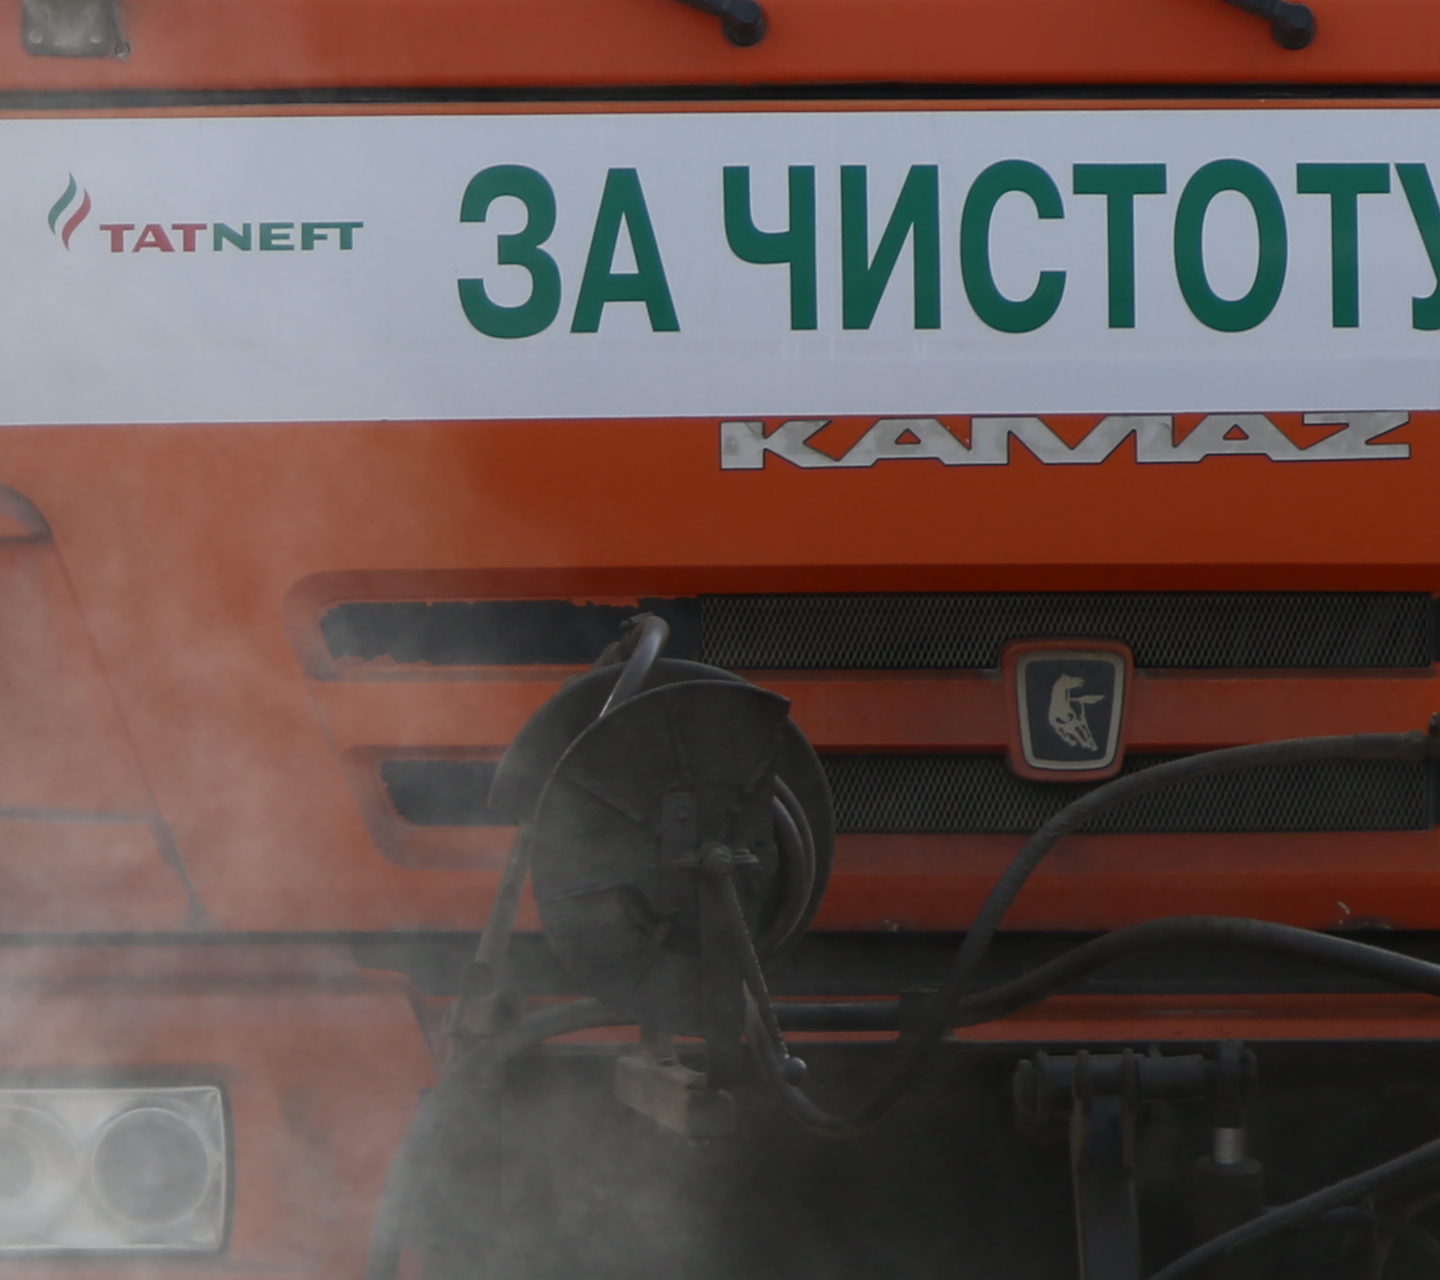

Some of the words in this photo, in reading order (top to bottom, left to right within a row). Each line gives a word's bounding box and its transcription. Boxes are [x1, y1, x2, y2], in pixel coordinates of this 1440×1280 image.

[99, 220, 364, 253] TATNEFT
[456, 163, 680, 340] ЗА
[720, 410, 1411, 470] KAMAZ
